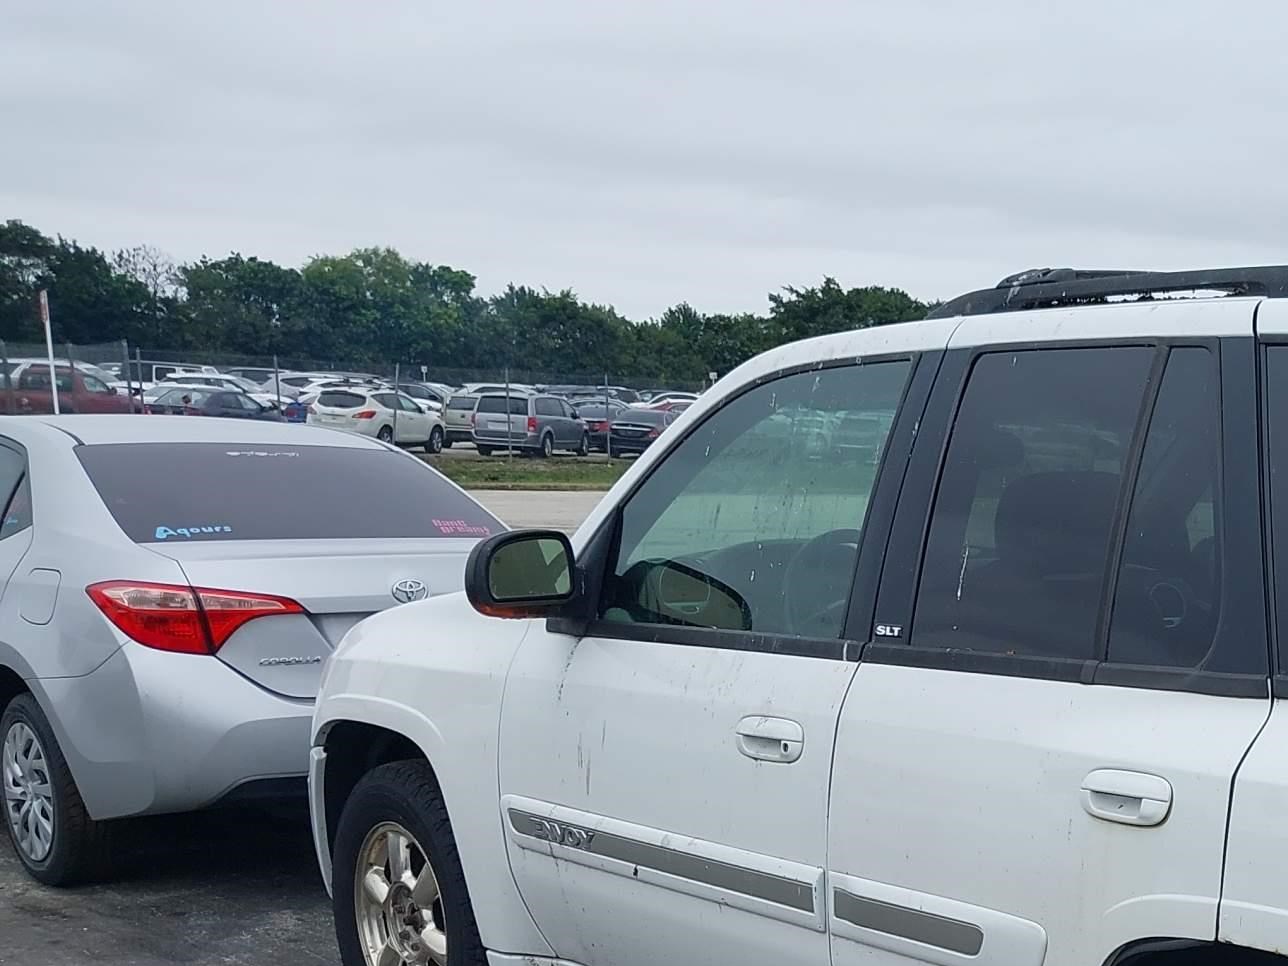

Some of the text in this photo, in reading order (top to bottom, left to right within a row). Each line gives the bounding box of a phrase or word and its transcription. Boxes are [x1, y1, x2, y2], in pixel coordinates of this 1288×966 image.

[155, 526, 232, 539] Aqours
[875, 625, 902, 637] SLT
[530, 817, 595, 850] ENVOY
